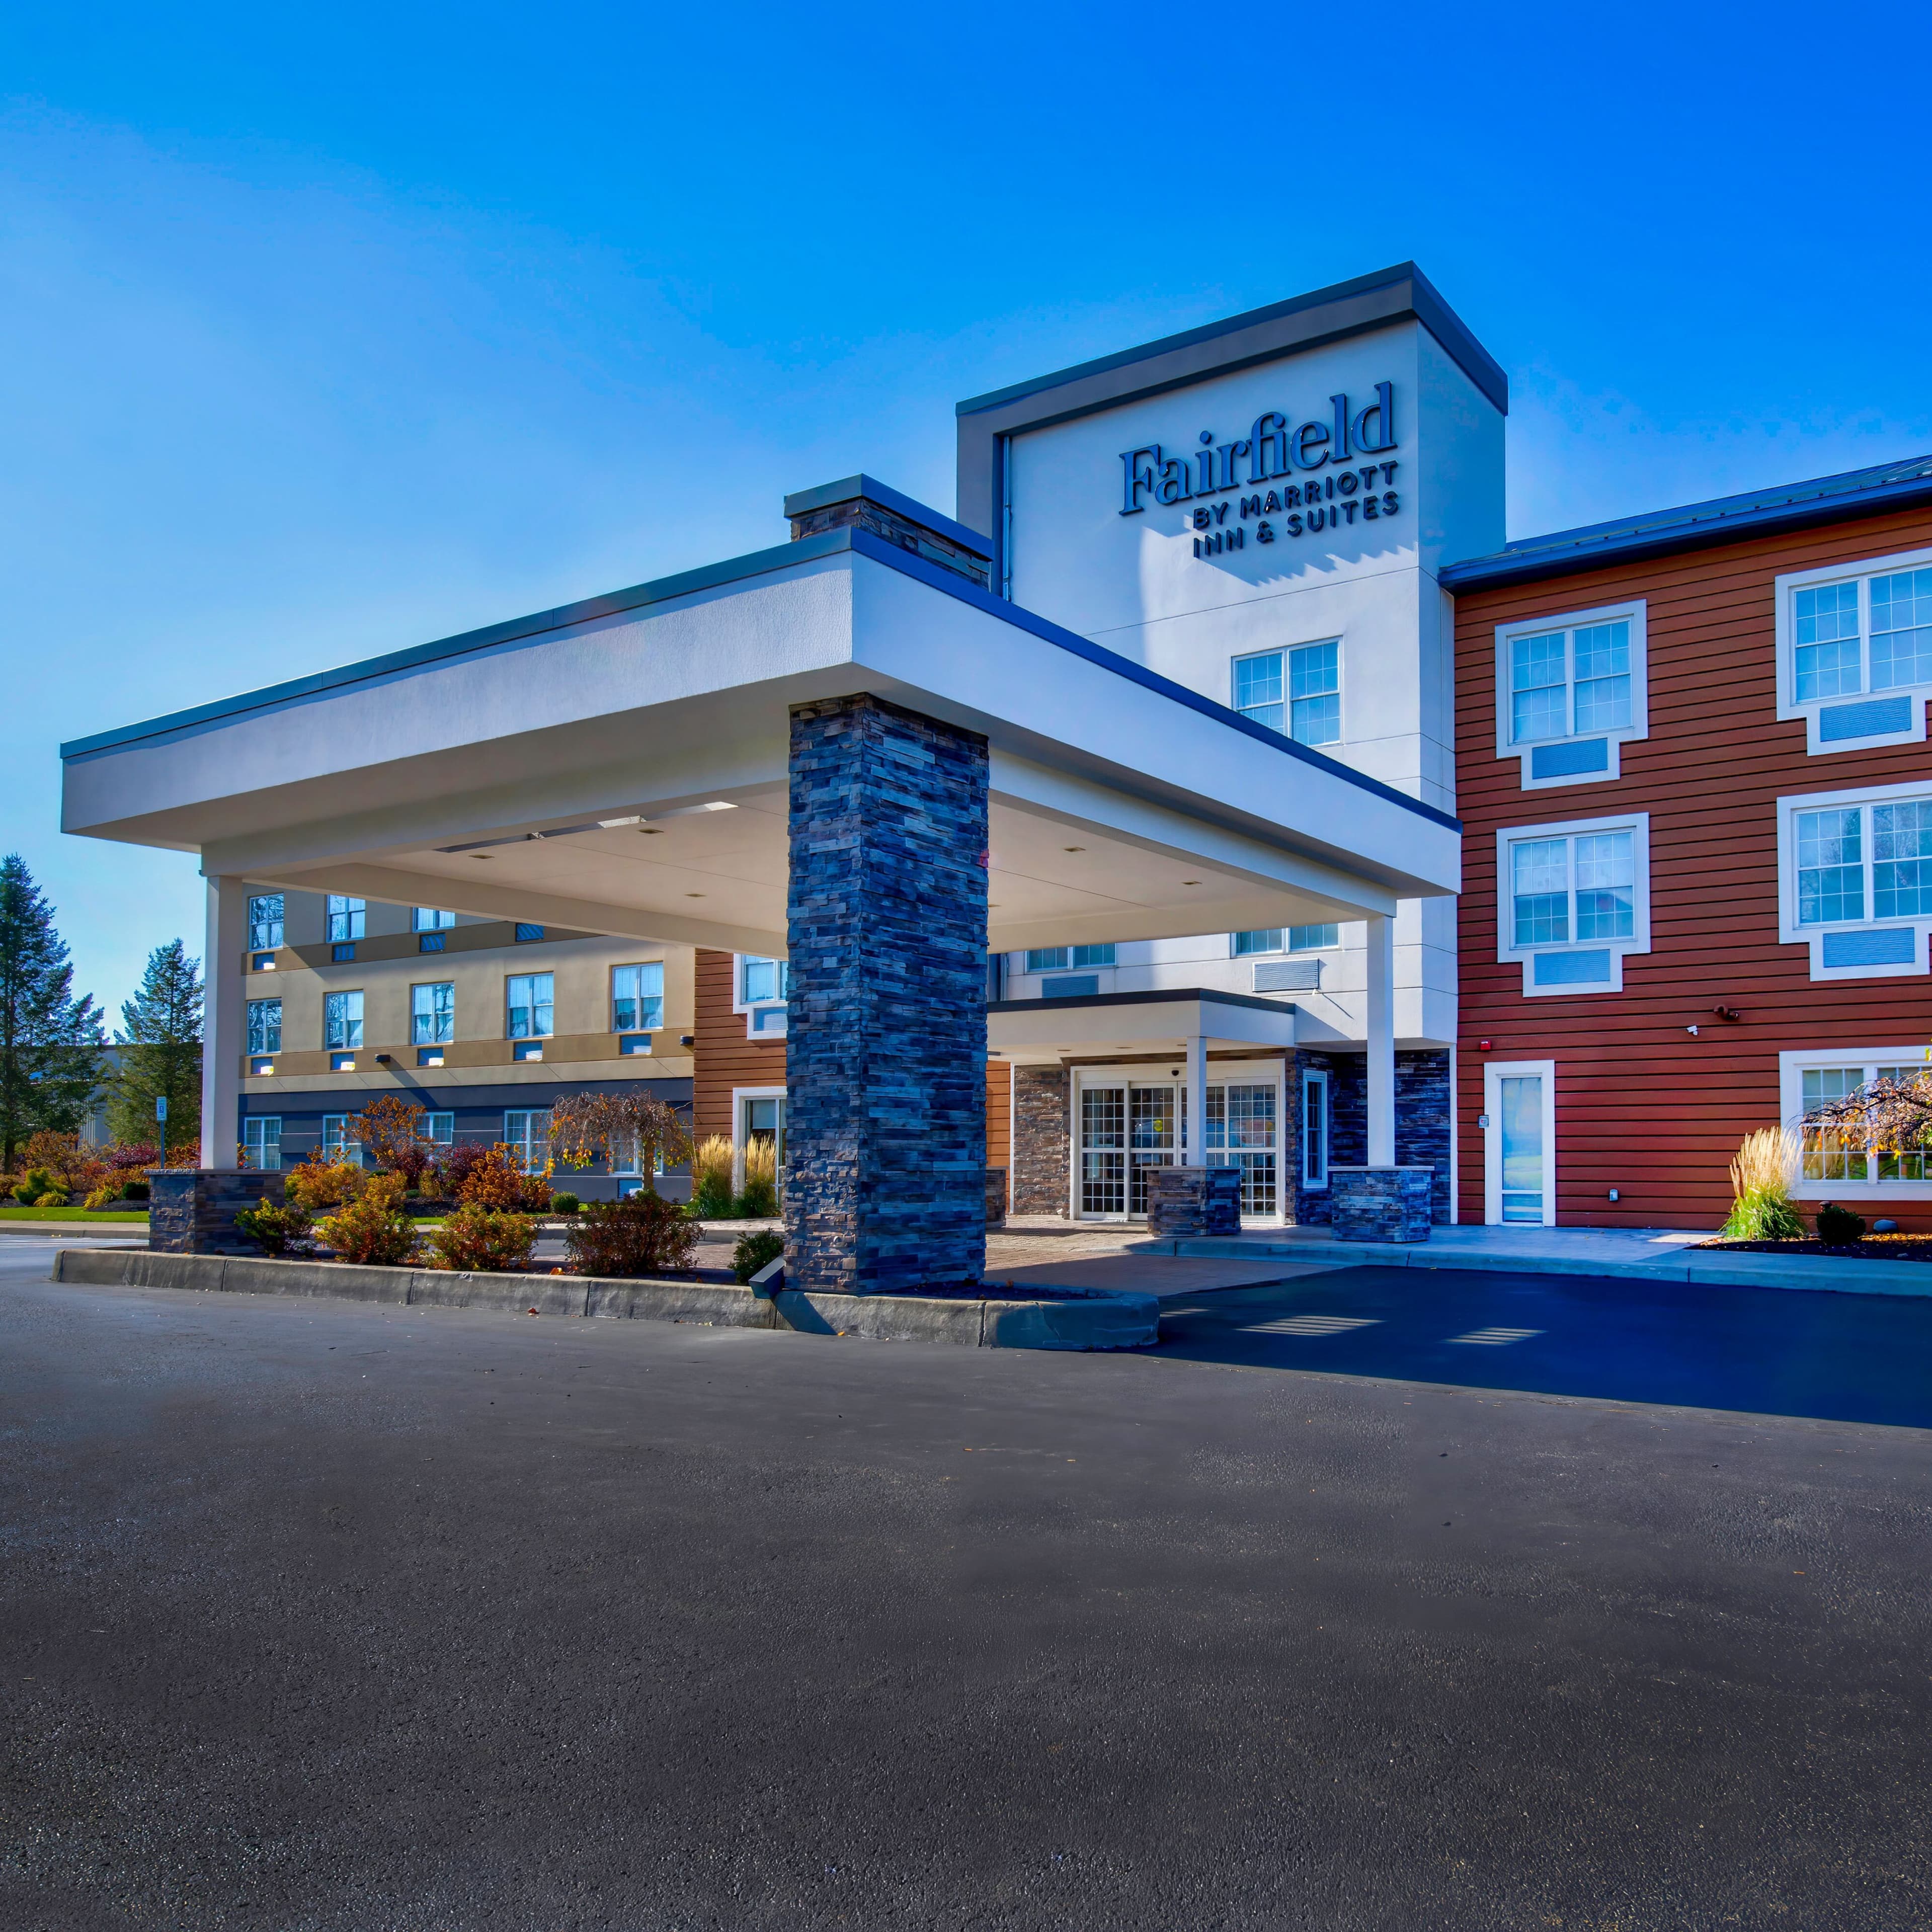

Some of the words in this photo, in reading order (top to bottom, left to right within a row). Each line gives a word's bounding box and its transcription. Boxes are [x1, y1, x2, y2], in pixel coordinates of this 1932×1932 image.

[1118, 381, 1398, 516] Fairfield
[1193, 502, 1229, 530] BY
[1240, 460, 1398, 520] MARRIOTT
[1193, 527, 1243, 558] INN
[1256, 520, 1274, 544] &
[1287, 491, 1398, 537] SUITES
